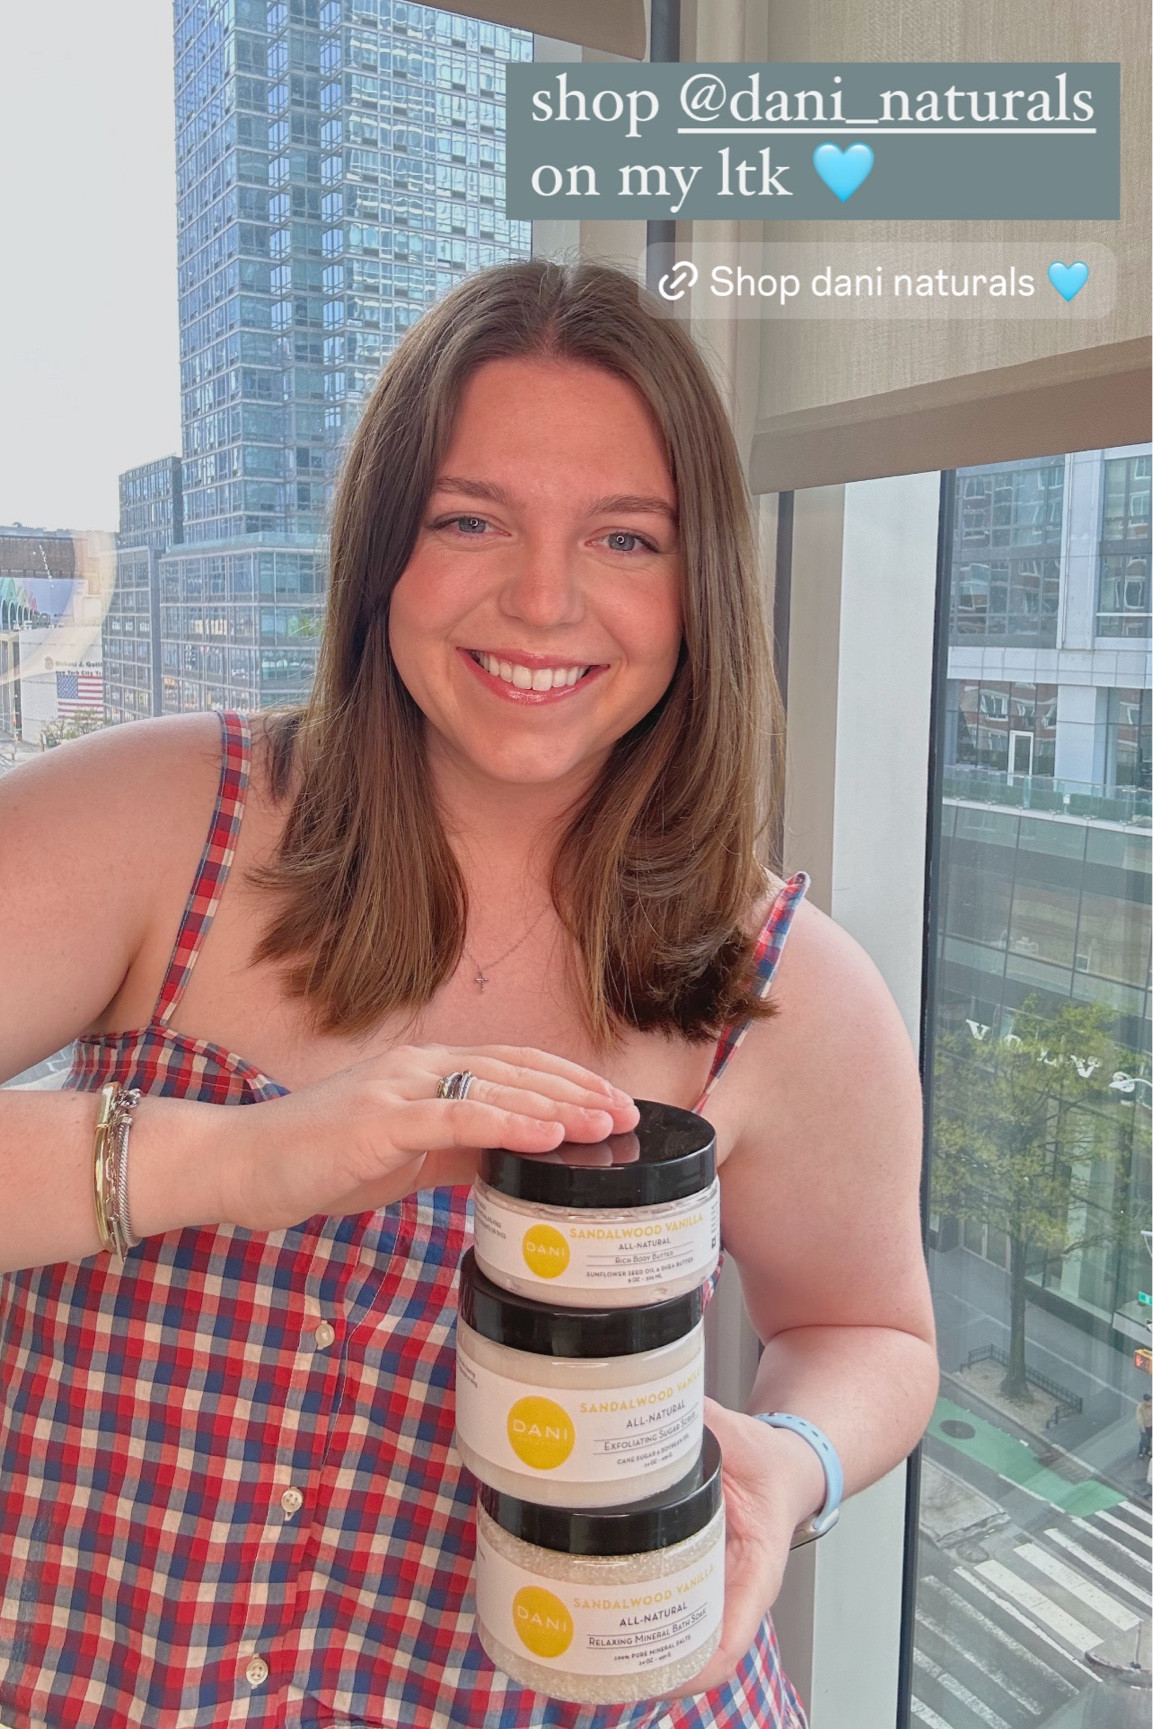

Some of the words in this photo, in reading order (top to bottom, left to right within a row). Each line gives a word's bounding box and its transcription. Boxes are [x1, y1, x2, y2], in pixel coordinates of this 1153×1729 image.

[570, 1224, 662, 1240] SANDALWOOD
[666, 1212, 704, 1232] VANILLA
[526, 1242, 565, 1257] DANI
[618, 1238, 671, 1250] ALL-NATURAL
[580, 1388, 673, 1413] SANDALWOOD
[626, 1400, 685, 1428] ALL-NATURAL
[513, 1419, 568, 1441] DANI
[660, 1425, 680, 1438] SUGAR
[617, 1457, 634, 1465] CANE
[573, 1590, 672, 1609] SANDALWOOD
[517, 1605, 568, 1632] DANI
[619, 1602, 687, 1627] ALL-NATURAL
[635, 1630, 670, 1643] MINERAL
[650, 1643, 674, 1654] MINERAL
